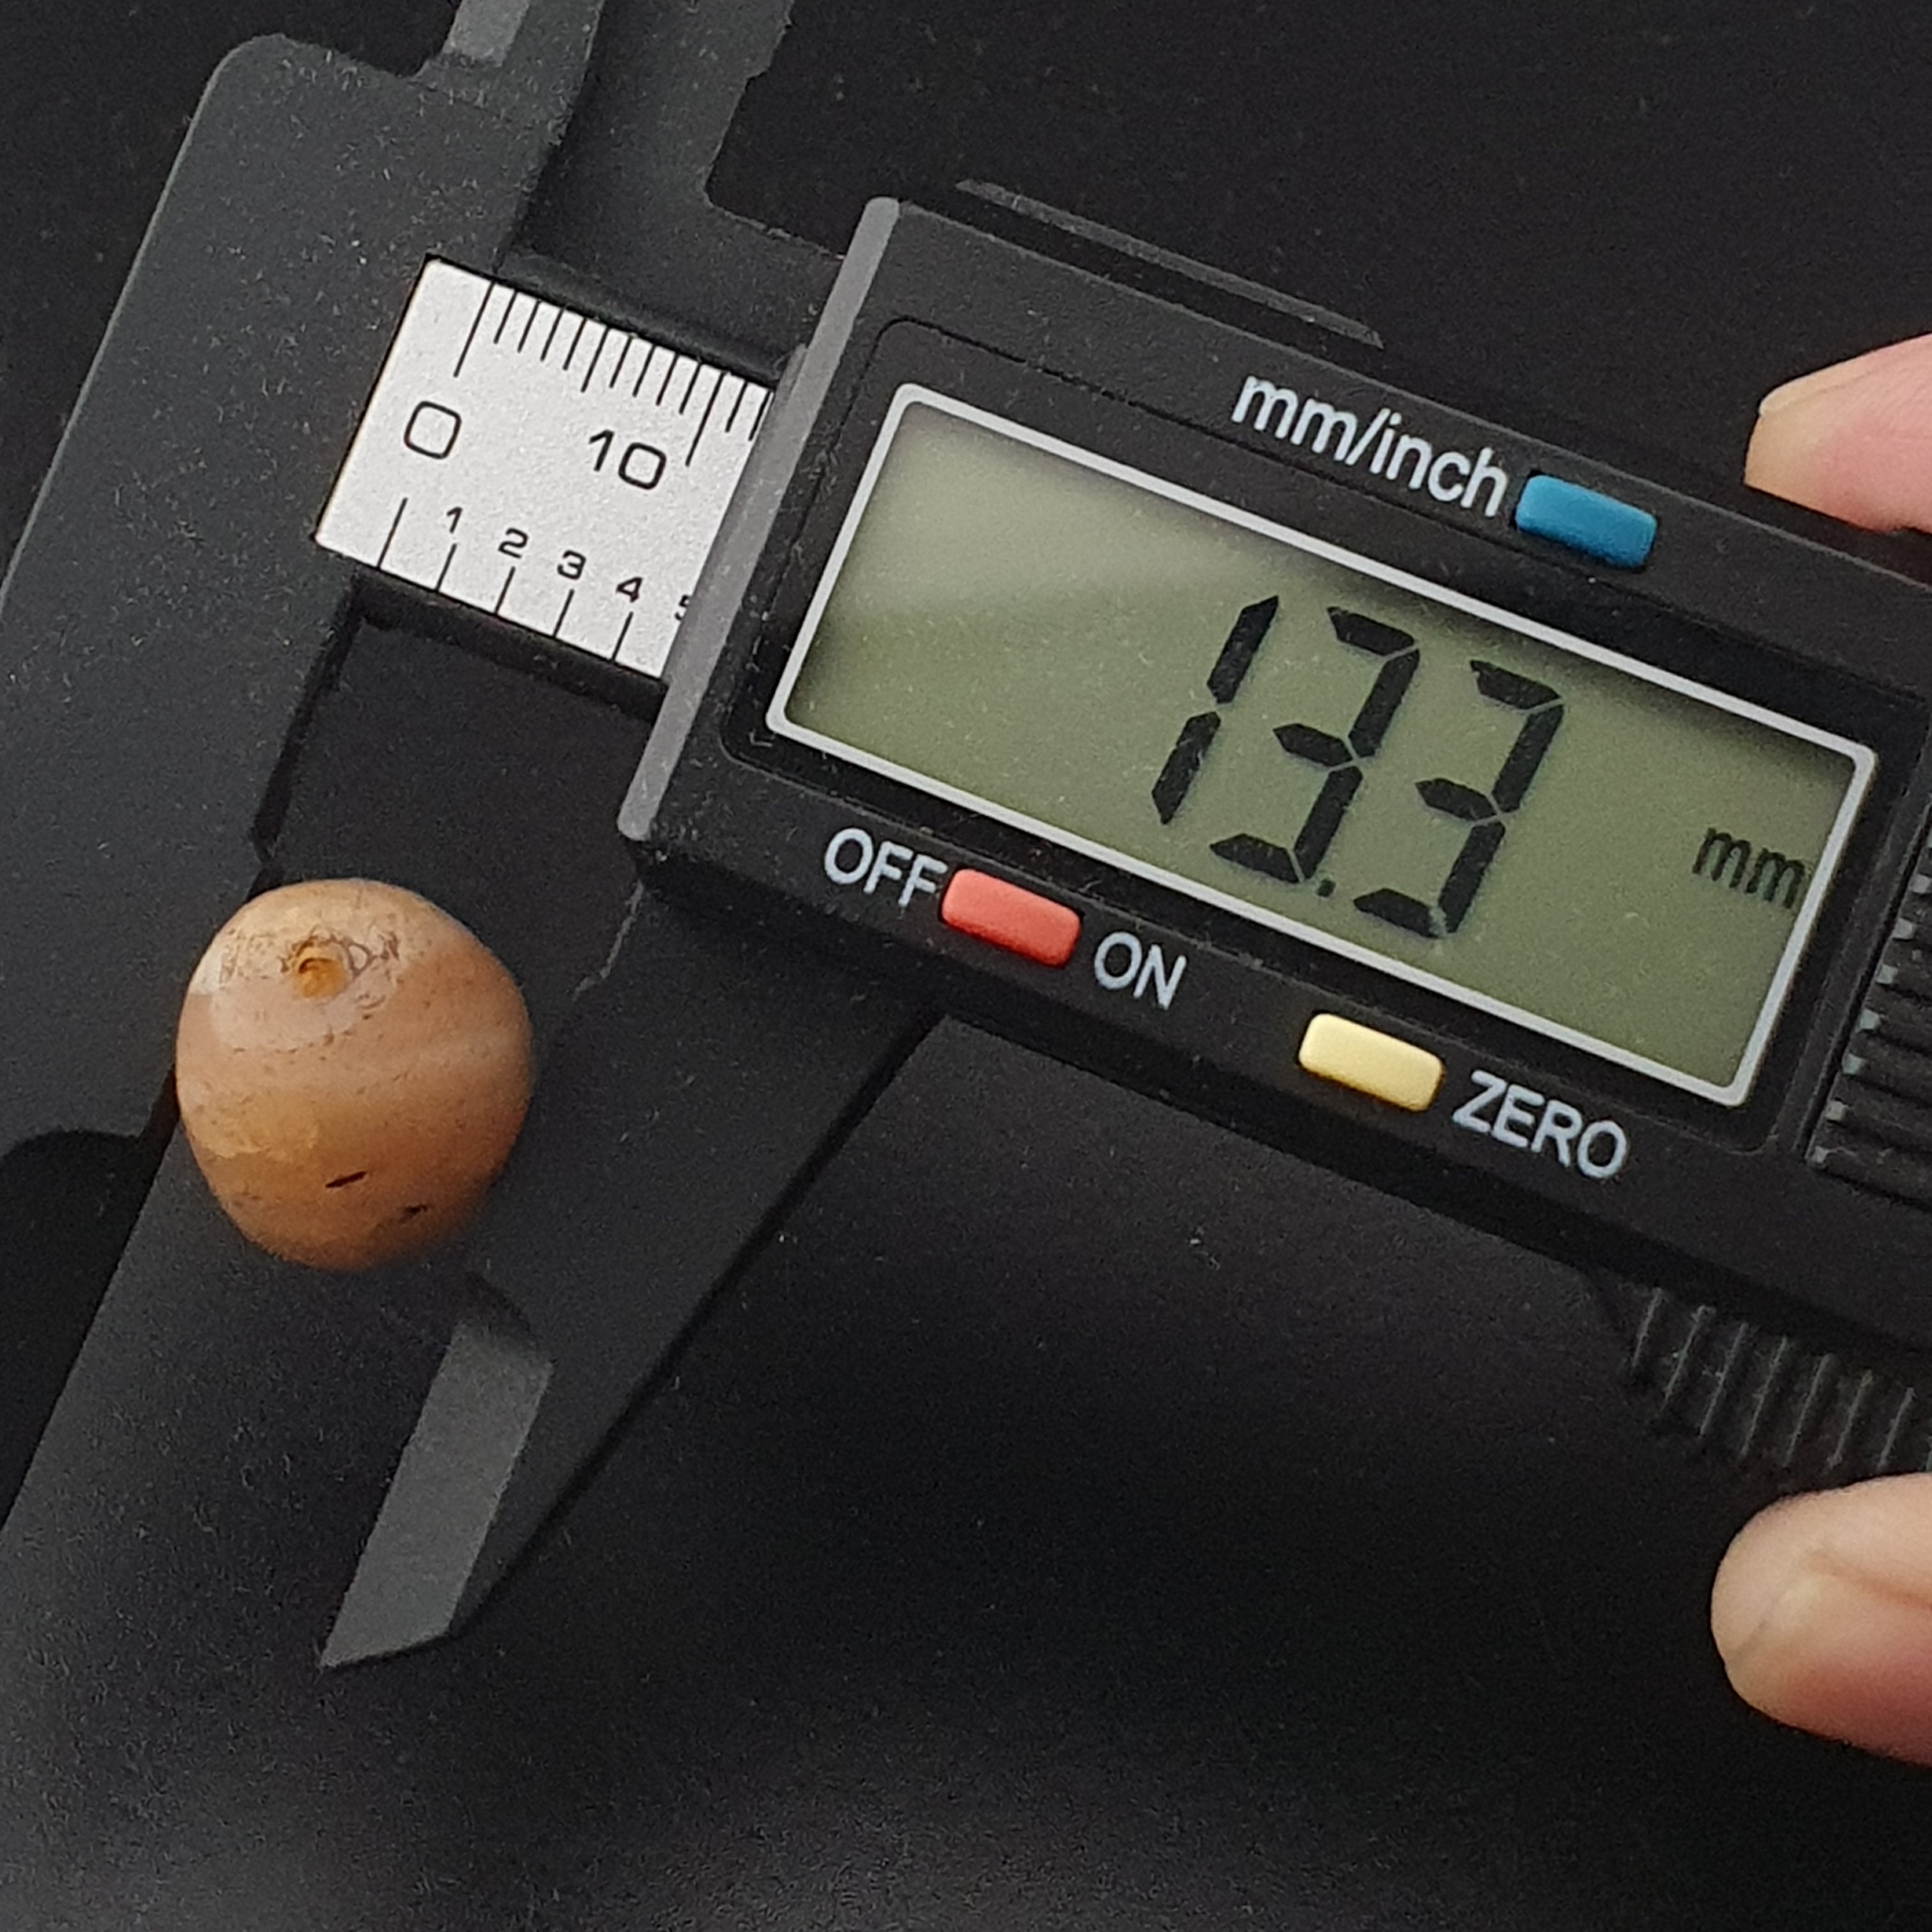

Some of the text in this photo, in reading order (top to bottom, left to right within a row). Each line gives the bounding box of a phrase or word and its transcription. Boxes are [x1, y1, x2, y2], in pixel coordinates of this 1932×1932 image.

[404, 401, 666, 490] 0 10
[1230, 375, 1510, 518] mm/inch
[446, 507, 644, 603] 1 2 3 4
[824, 827, 948, 907] OFF
[1692, 827, 1805, 909] mm
[1092, 930, 1187, 1011] ON
[1452, 1070, 1627, 1179] ZERO
